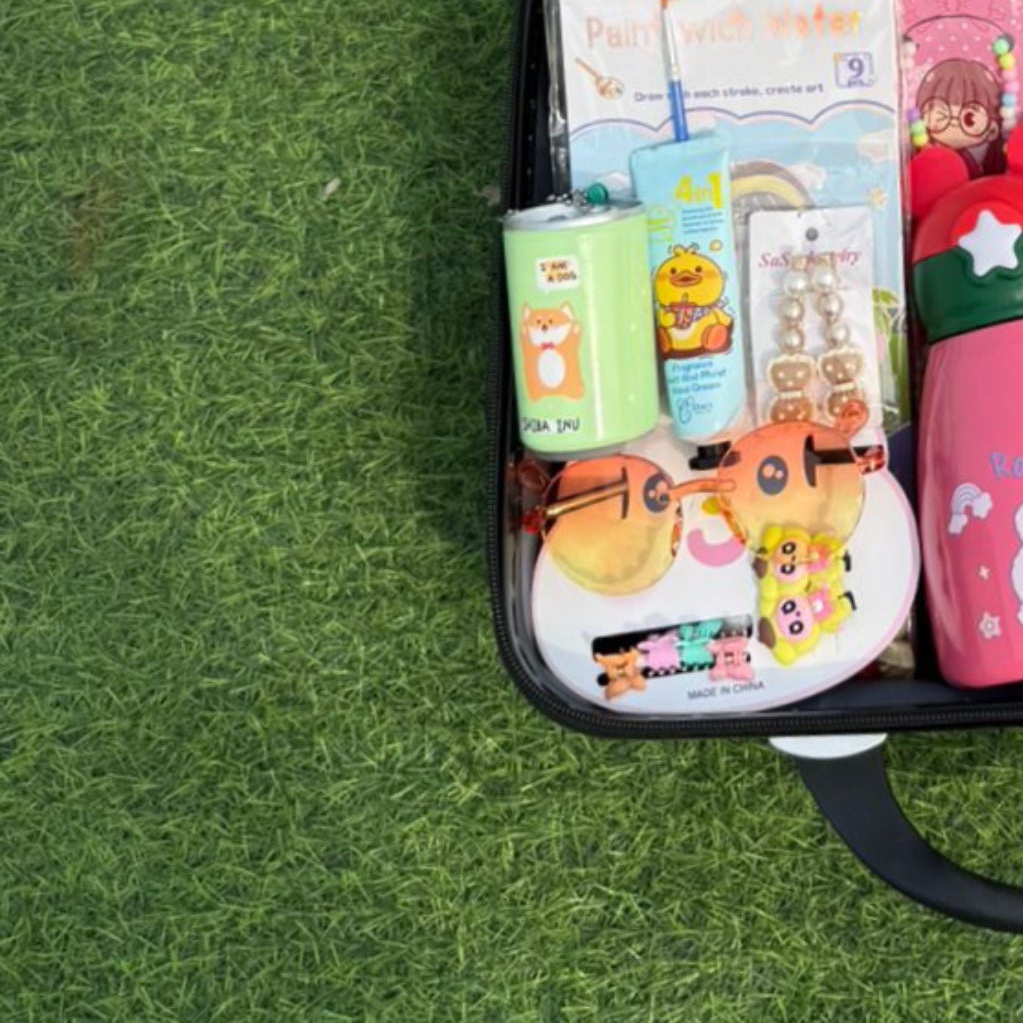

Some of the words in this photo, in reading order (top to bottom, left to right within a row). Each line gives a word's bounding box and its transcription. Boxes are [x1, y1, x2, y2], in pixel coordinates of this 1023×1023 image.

[848, 57, 864, 78] 9
[688, 686, 716, 699] MADE
[733, 680, 766, 694] CHINA
